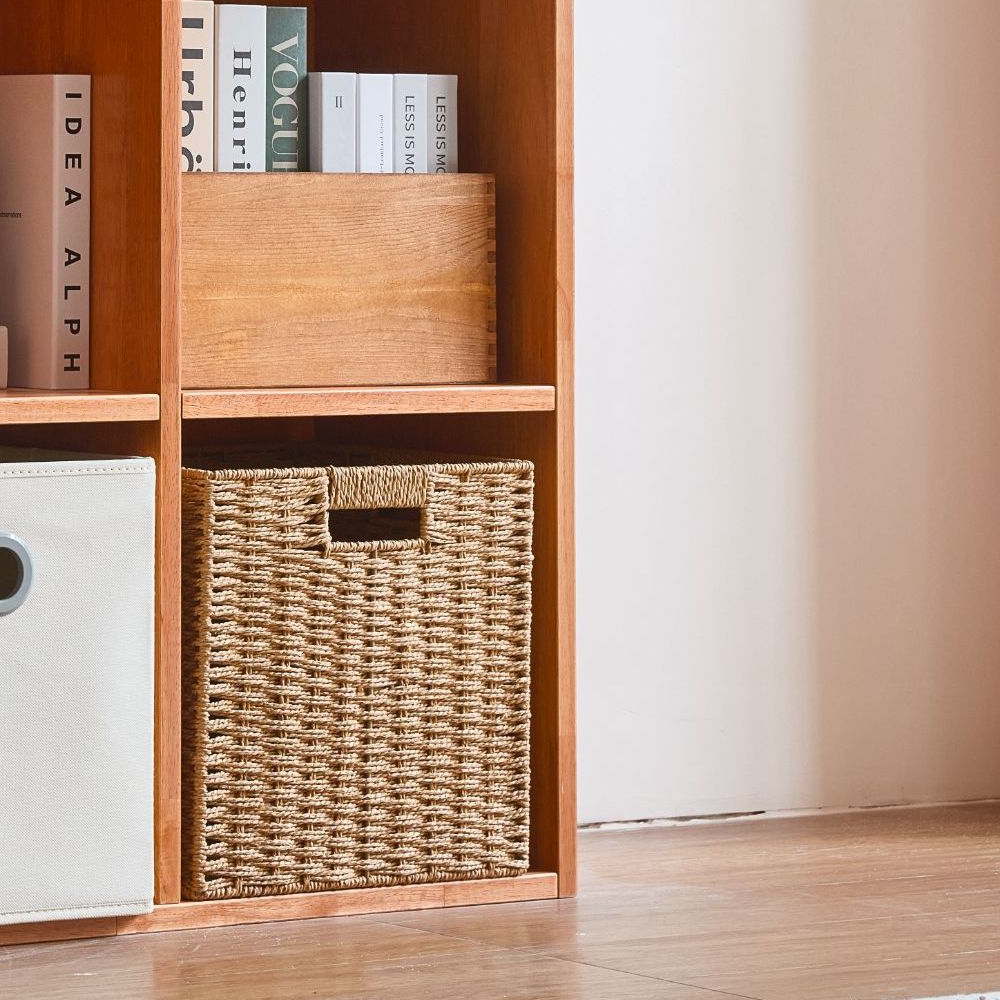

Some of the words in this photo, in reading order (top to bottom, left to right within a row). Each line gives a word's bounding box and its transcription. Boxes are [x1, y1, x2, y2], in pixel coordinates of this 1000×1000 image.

[232, 47, 252, 170] Henri
[404, 95, 416, 132] LESS
[435, 96, 447, 132] LESS
[64, 92, 83, 207] IDEA
[404, 136, 415, 150] IS
[435, 136, 447, 150] IS
[63, 247, 82, 372] ALPH
